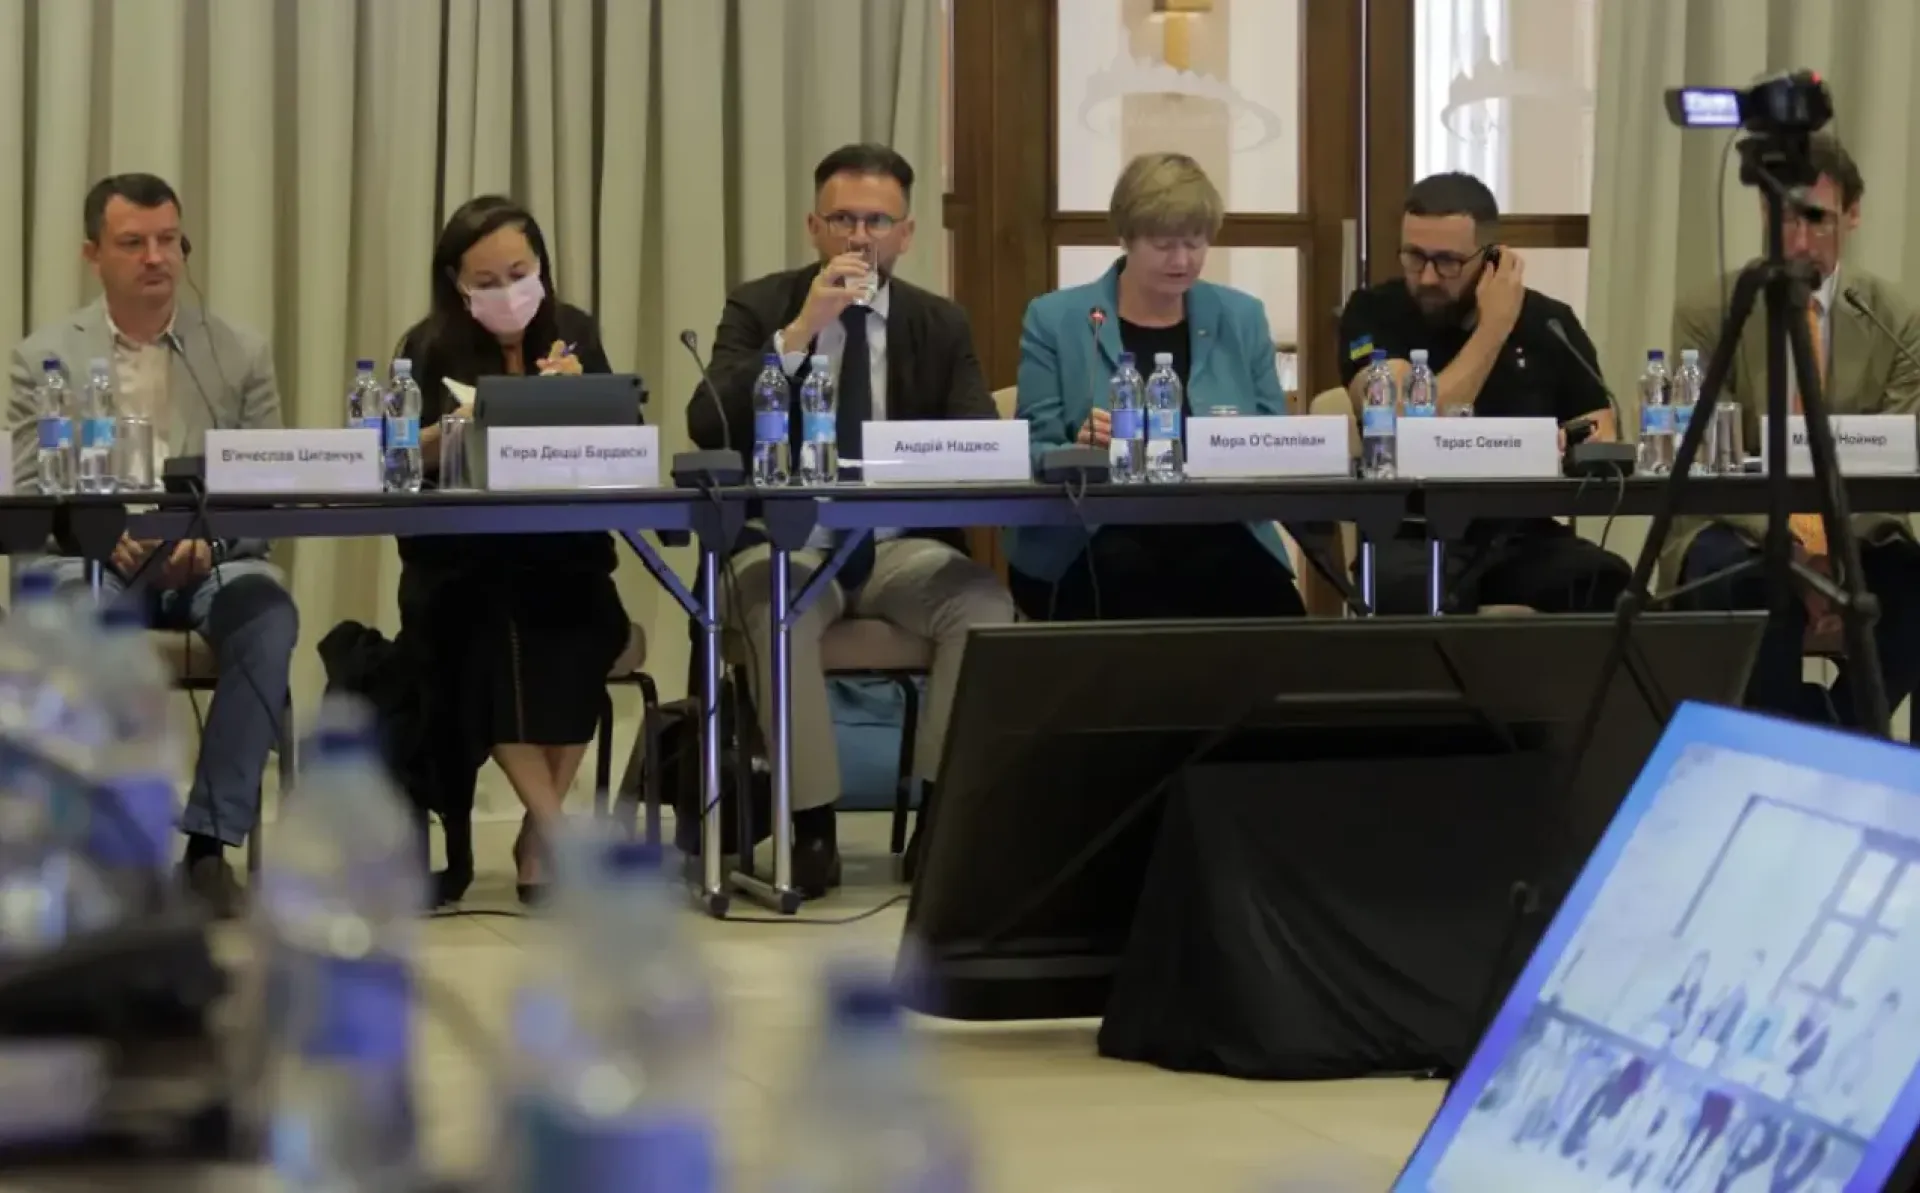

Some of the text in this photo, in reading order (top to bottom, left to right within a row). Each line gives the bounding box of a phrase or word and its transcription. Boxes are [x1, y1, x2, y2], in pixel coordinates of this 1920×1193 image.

[894, 439, 943, 454] Андрій
[1210, 434, 1246, 448] Мора
[1433, 435, 1523, 450] Тарас Семків
[1838, 433, 1888, 447] Нойнер
